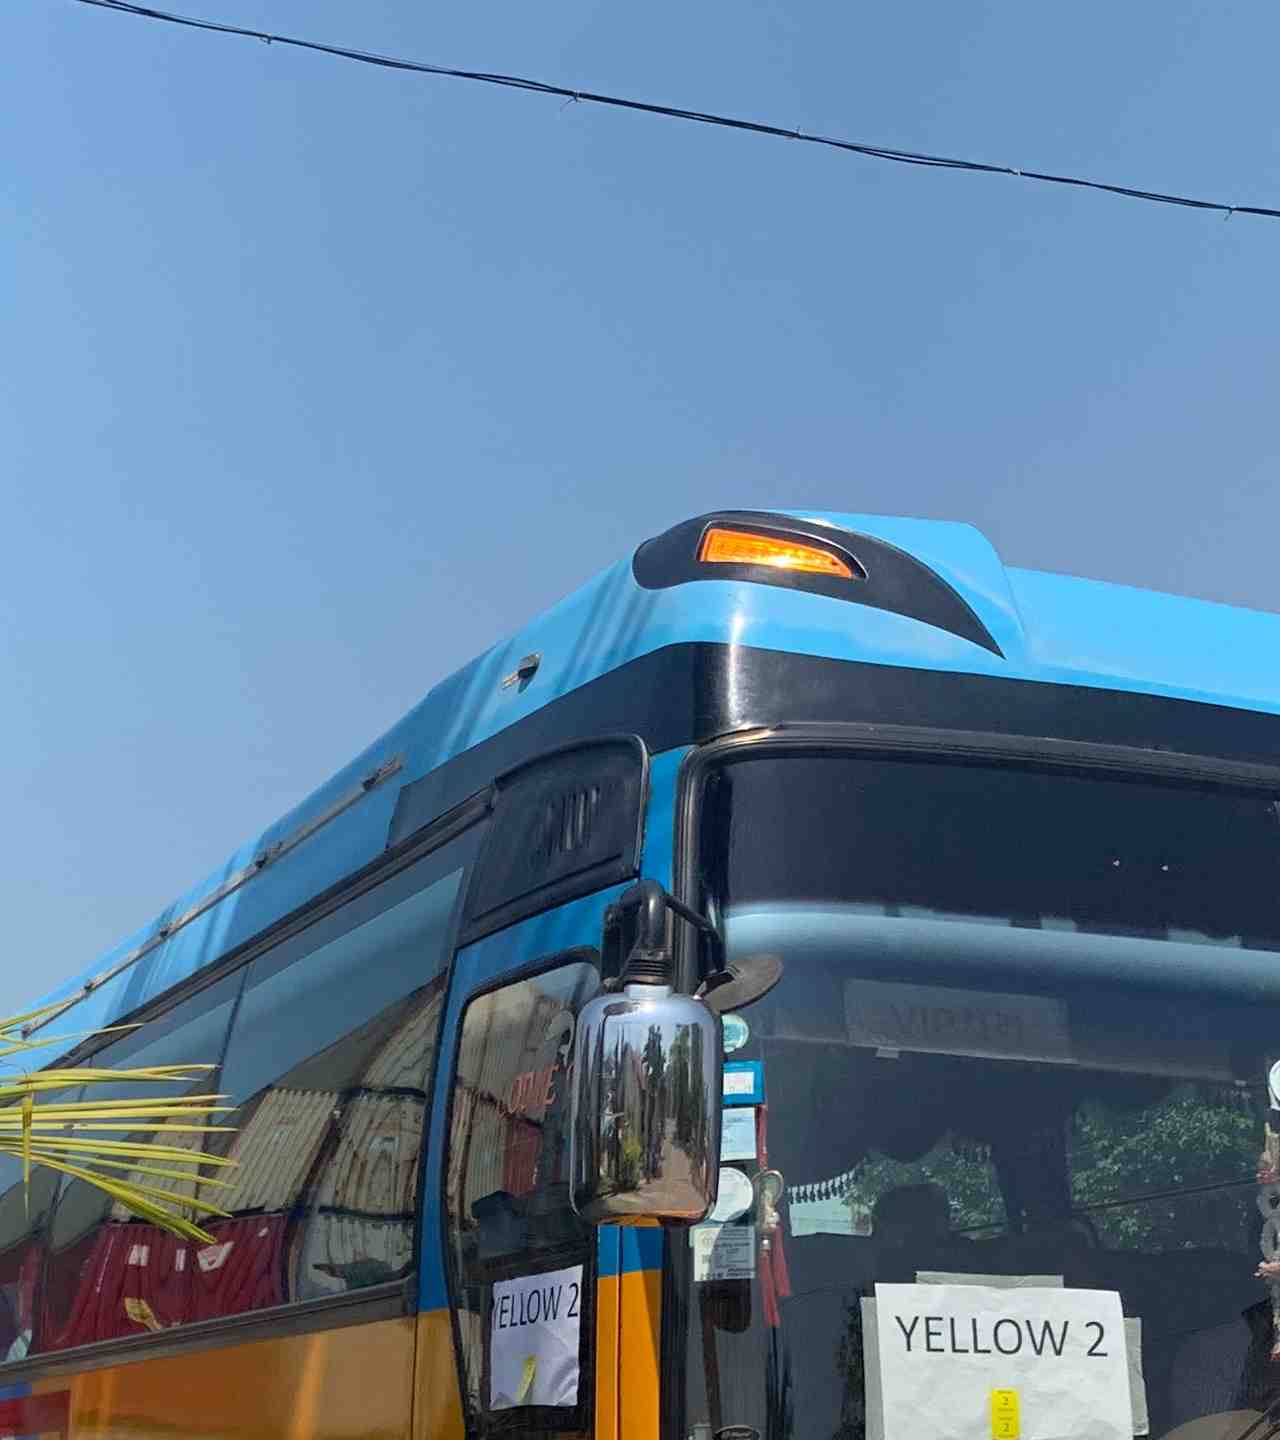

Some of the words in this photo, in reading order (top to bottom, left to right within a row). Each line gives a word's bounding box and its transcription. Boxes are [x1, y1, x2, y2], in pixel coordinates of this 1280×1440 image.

[567, 1282, 579, 1318] 2
[895, 1315, 1070, 1357] YELLOW
[1084, 1320, 1109, 1358] 2
